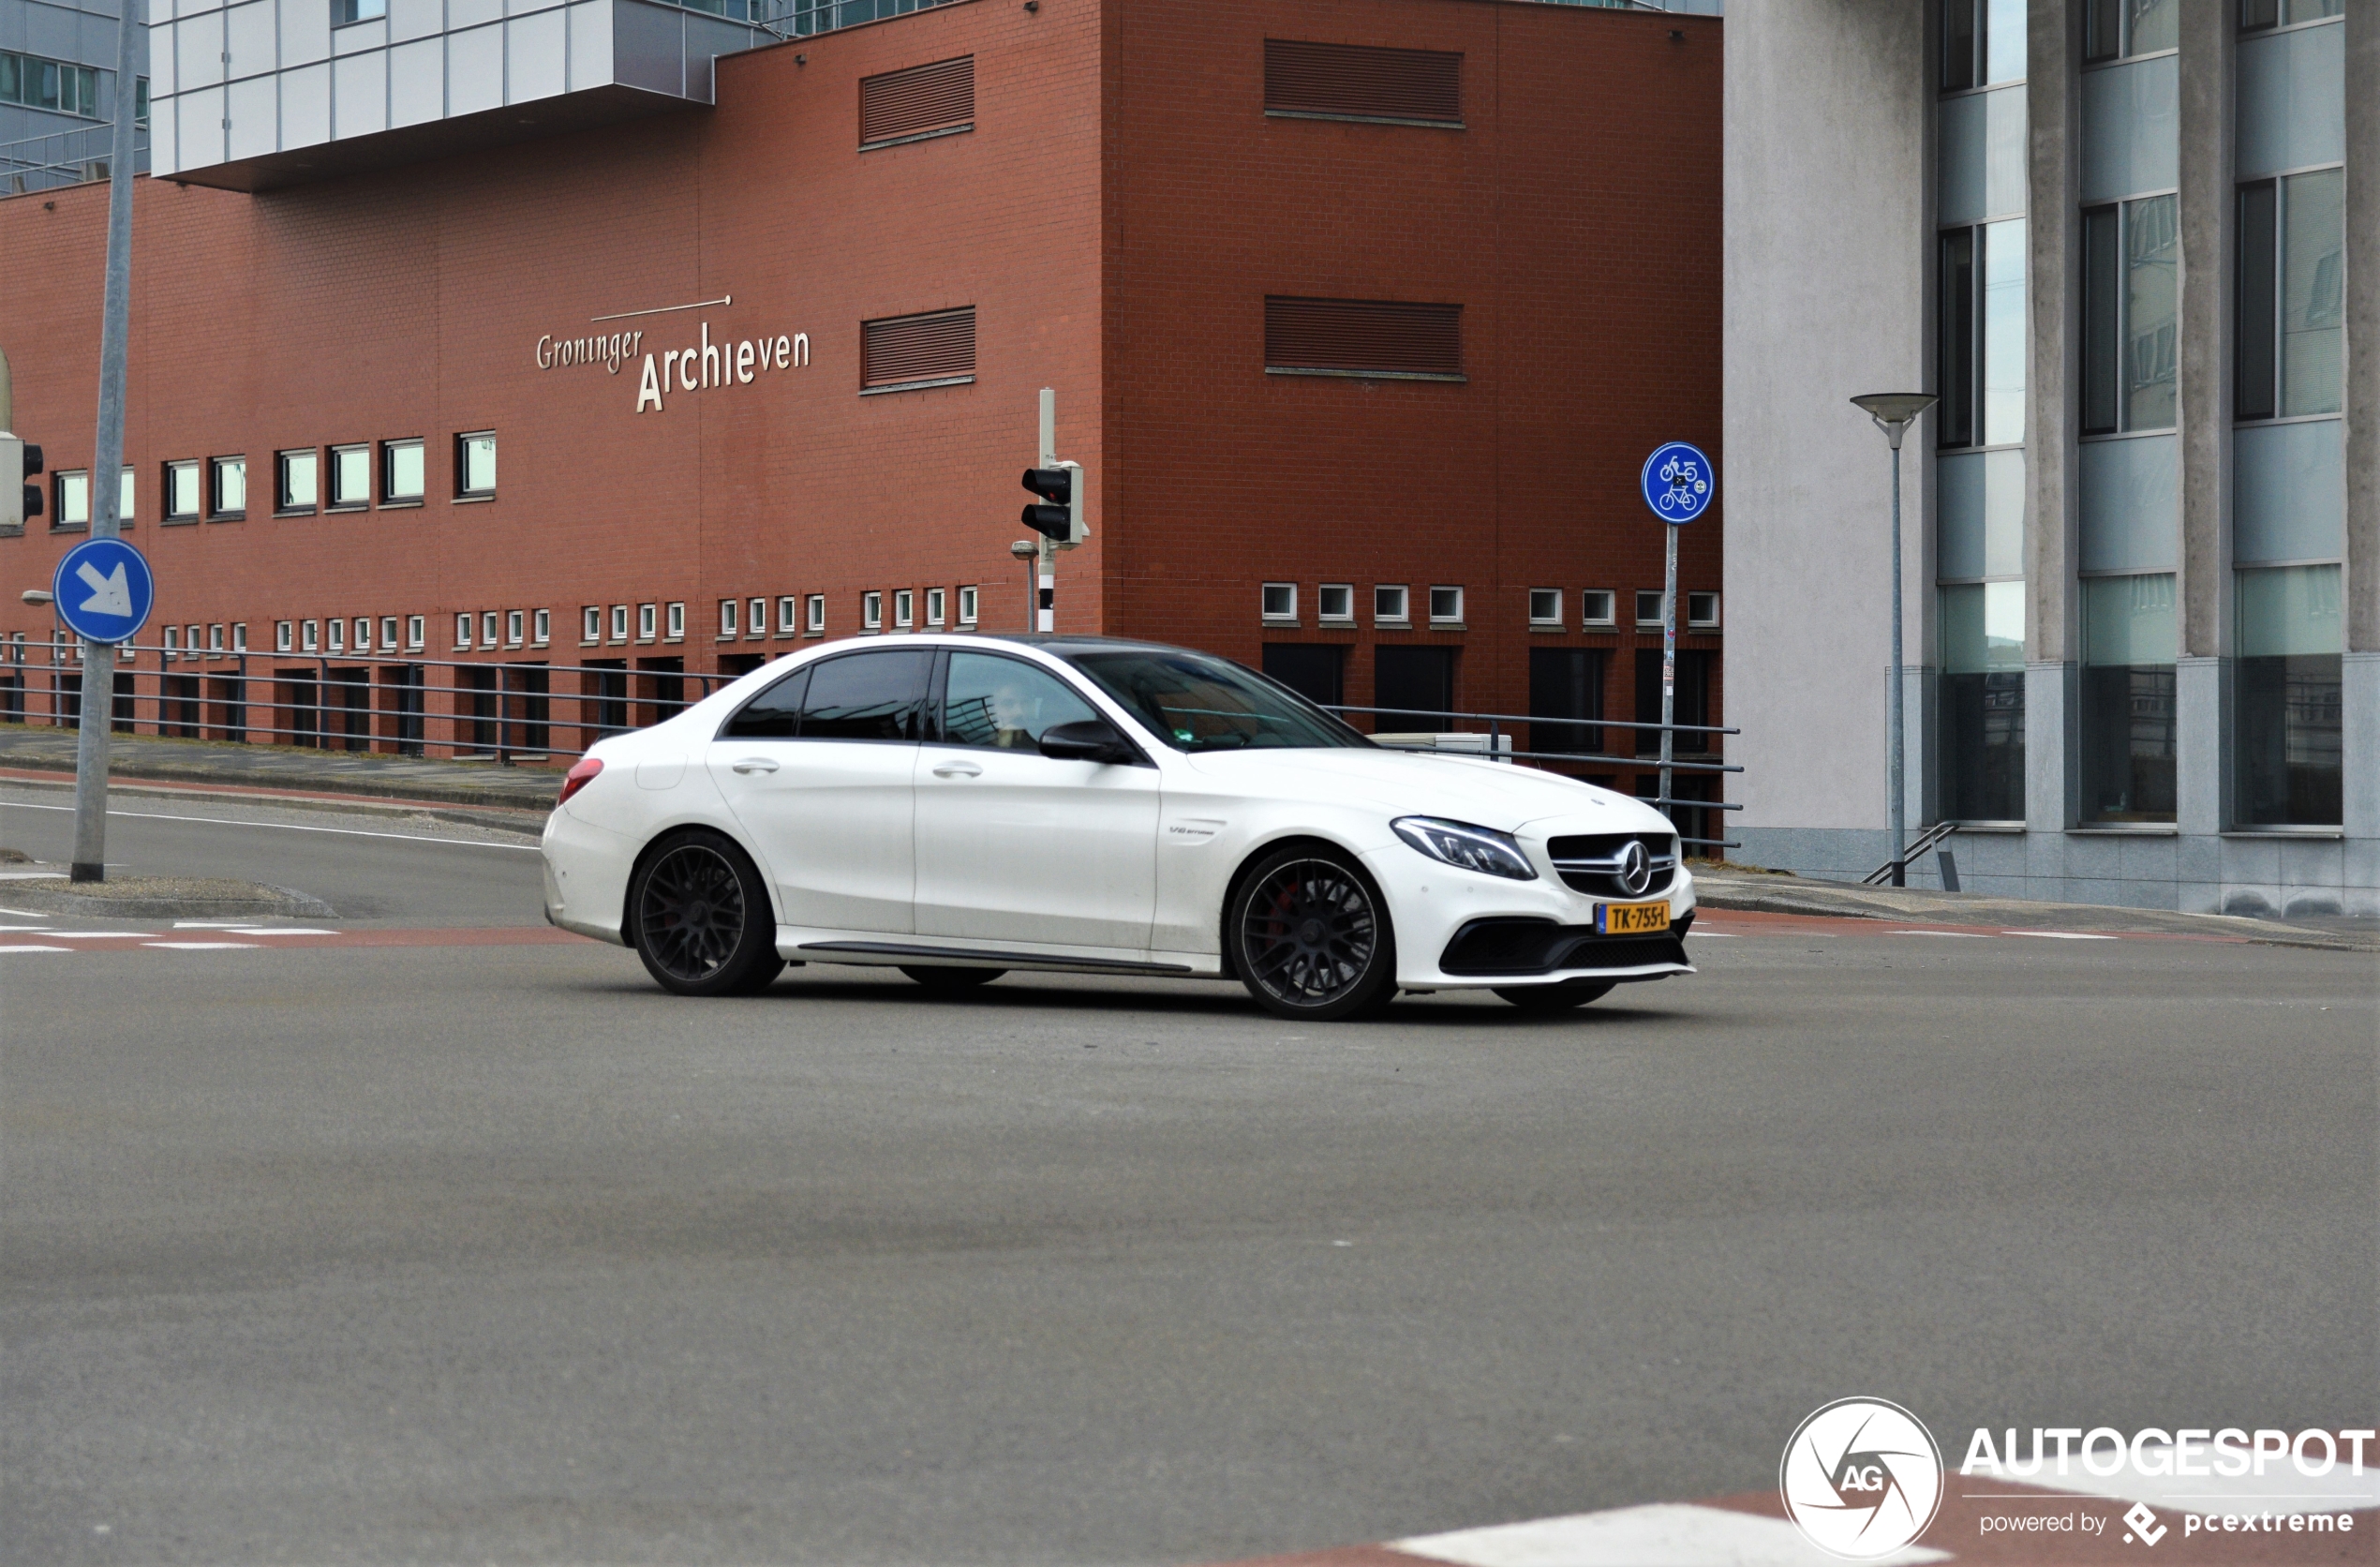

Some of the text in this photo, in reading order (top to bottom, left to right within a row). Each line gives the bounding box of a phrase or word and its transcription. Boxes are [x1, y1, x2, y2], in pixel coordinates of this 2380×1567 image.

[537, 321, 810, 413] Groninger Archieven
[1613, 905, 1667, 930] TK-755-L
